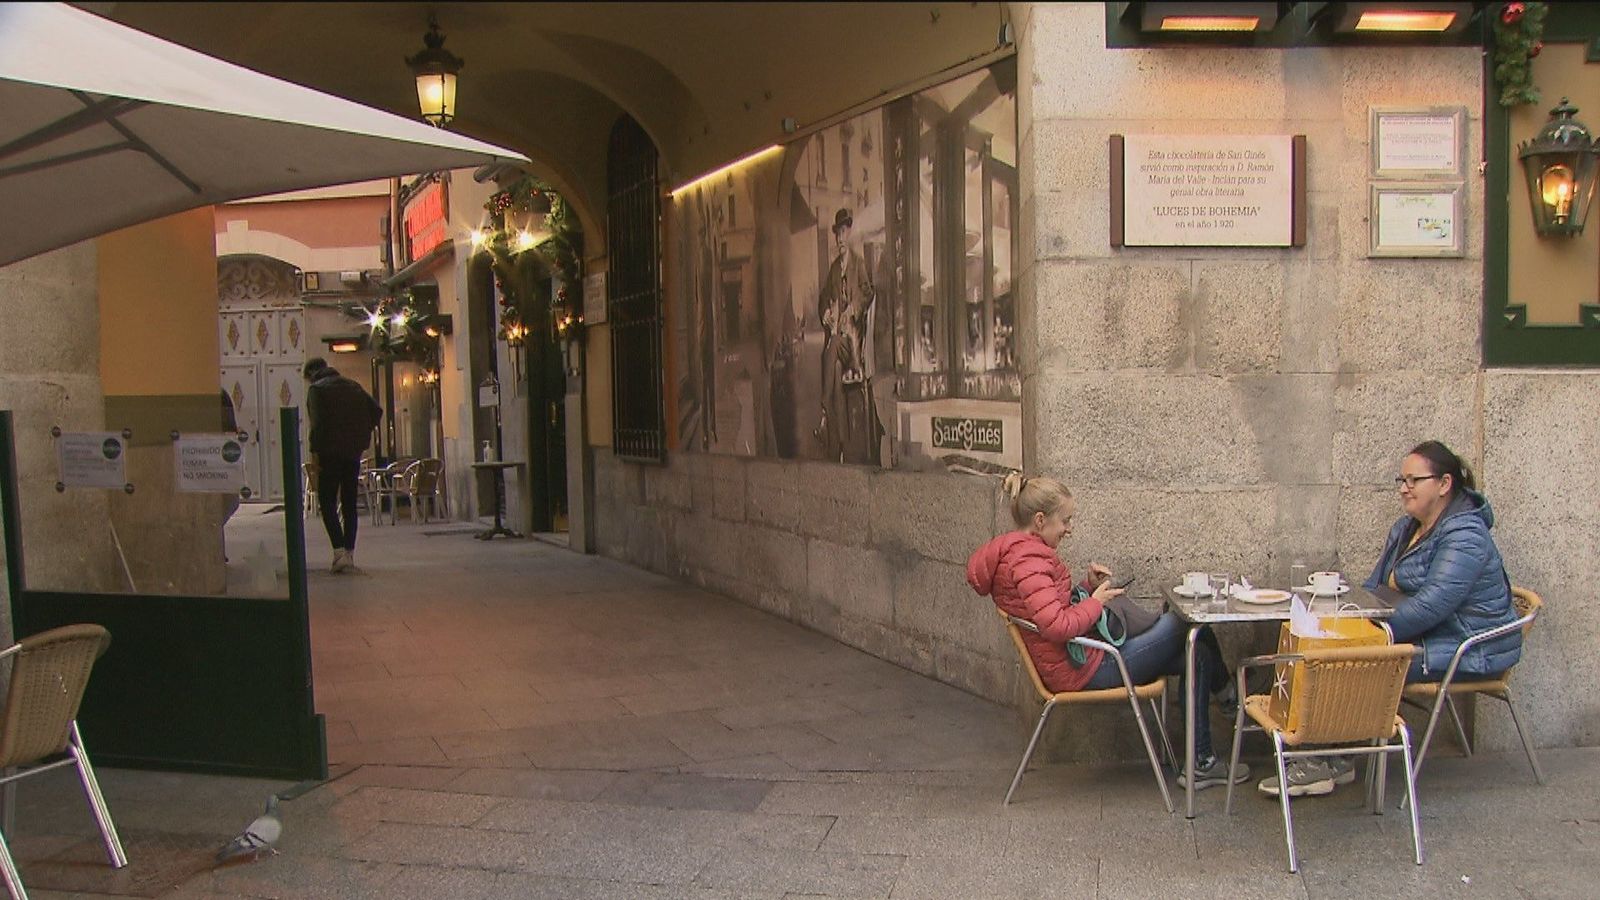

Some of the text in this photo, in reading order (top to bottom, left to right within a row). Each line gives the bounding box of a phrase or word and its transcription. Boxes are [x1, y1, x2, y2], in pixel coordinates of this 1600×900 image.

[1148, 149, 1165, 160] Esta
[1216, 149, 1227, 160] de
[1227, 149, 1242, 160] San
[1244, 149, 1266, 160] Ginés
[1162, 164, 1184, 173] como
[1185, 162, 1228, 175] inspiración
[1248, 162, 1274, 173] Ramón
[1148, 174, 1171, 185] María
[1172, 174, 1184, 185] del
[1186, 174, 1206, 185] Valle
[1237, 176, 1255, 186] para
[1257, 176, 1266, 185] su
[1170, 186, 1244, 198] genial obra literaria
[1192, 206, 1207, 217] DE
[1175, 221, 1186, 229] en
[1187, 219, 1194, 229] el
[1196, 219, 1212, 229] año
